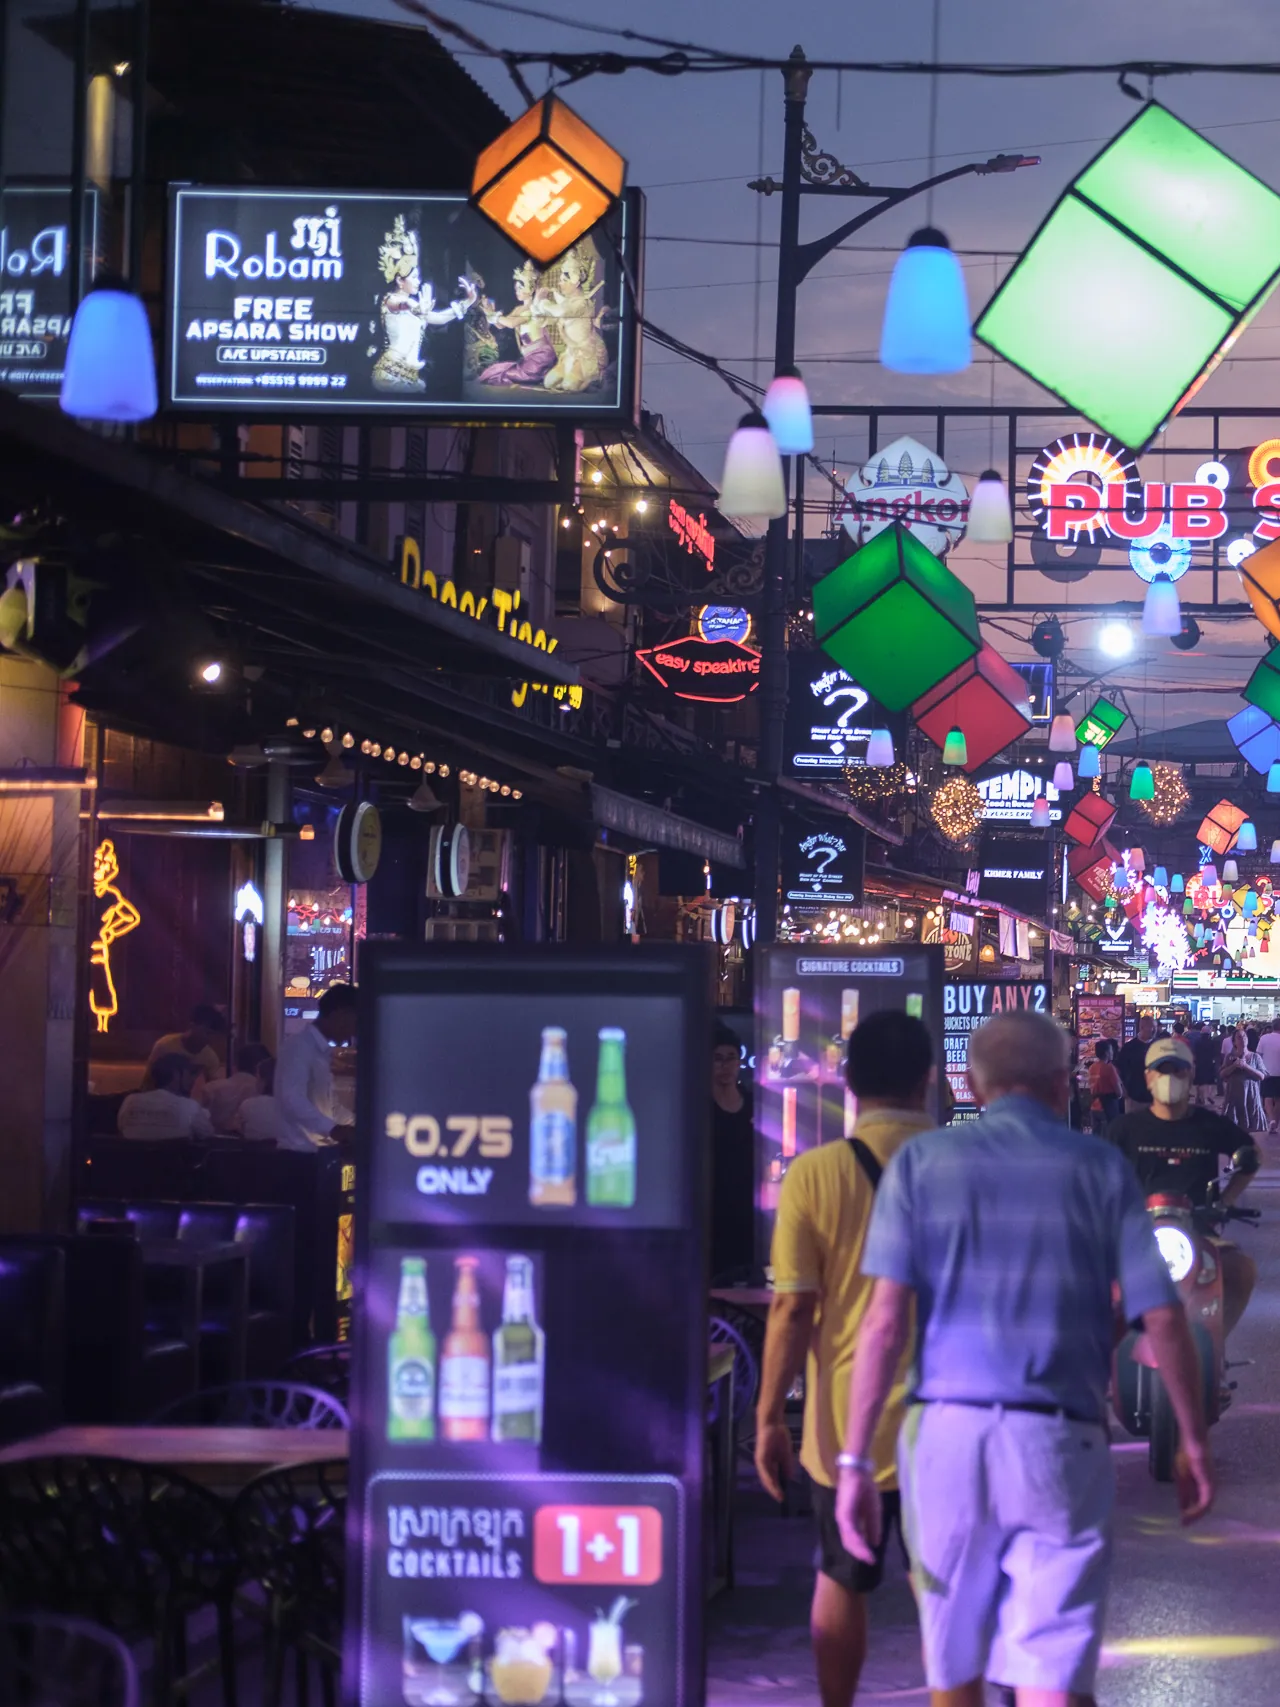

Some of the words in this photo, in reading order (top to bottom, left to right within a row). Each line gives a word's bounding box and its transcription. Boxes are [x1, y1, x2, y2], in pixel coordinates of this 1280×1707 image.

[205, 230, 343, 280] Robam
[234, 296, 314, 320] FREE
[186, 319, 282, 340] APSARA
[289, 322, 359, 341] SHOW
[223, 348, 248, 360] A/C
[250, 349, 320, 361] UPSTAIRS
[834, 490, 972, 530] Angkor
[1047, 482, 1228, 541] PUB
[655, 653, 690, 672] easy
[977, 770, 1059, 801] TEMPLE
[851, 961, 899, 973] COCKTAILS
[943, 985, 987, 1014] BUY
[992, 985, 1032, 1014] ANY
[1034, 984, 1047, 1014] 2
[944, 1037, 969, 1050] DRAFT
[946, 1050, 967, 1062] BEER
[386, 1112, 513, 1159] $0.75
[416, 1166, 494, 1194] ONLY
[556, 1513, 640, 1577] 1+1
[388, 1550, 523, 1579] COCKTAILS
